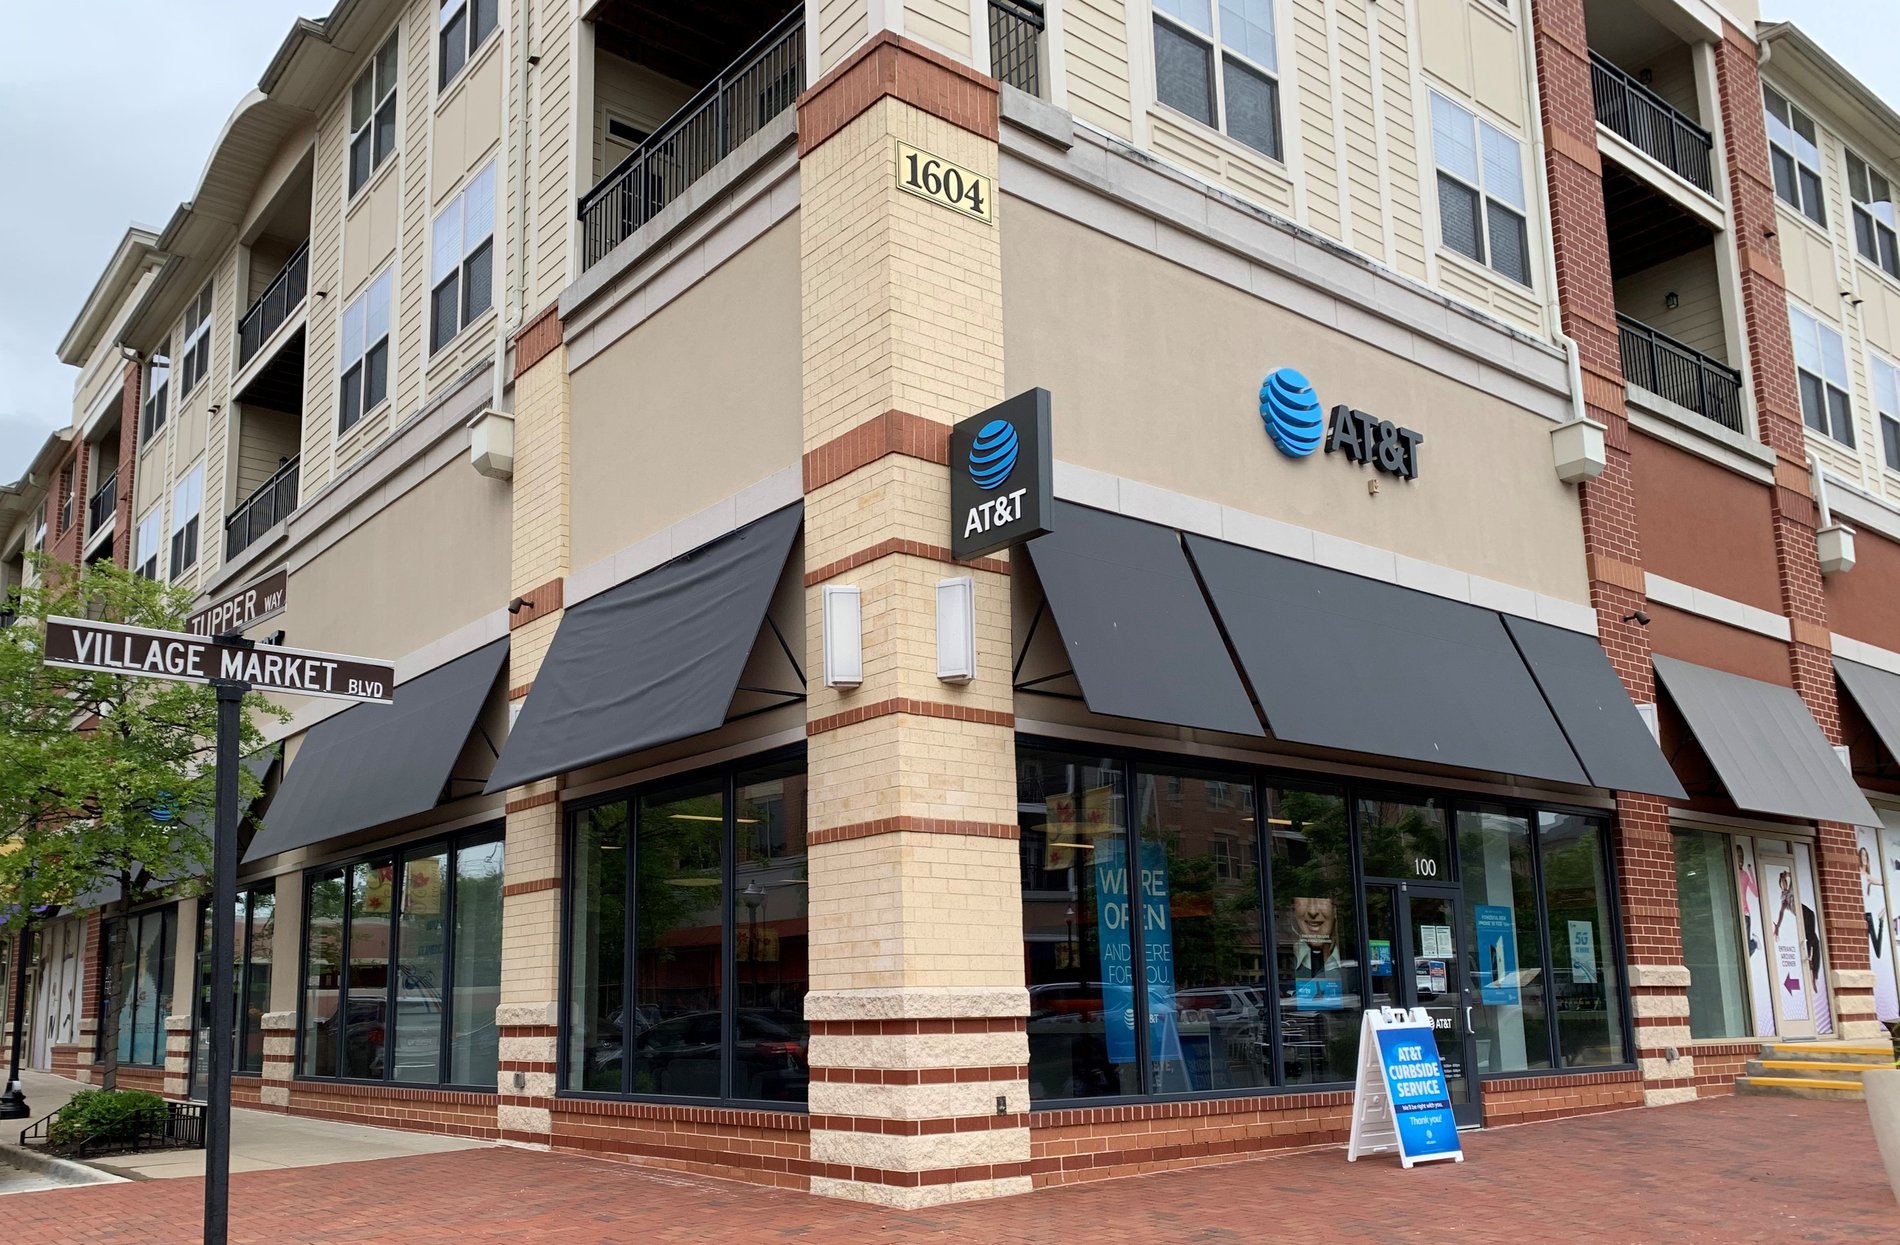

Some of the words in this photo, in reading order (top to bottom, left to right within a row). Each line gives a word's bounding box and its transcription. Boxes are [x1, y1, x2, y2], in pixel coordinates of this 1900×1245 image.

[905, 152, 985, 215] 1604
[1324, 404, 1424, 480] AT&T
[963, 487, 1027, 539] AT&T
[192, 589, 257, 638] TUPPER
[264, 589, 283, 613] WAY
[71, 629, 205, 677] VILLAGE
[220, 649, 338, 691] MARKET
[348, 678, 384, 698] BLVD
[1415, 857, 1437, 877] 100
[1099, 867, 1167, 896] WRE
[1104, 902, 1166, 931] OPN
[1574, 931, 1588, 945] 5G
[1104, 943, 1132, 961] AND
[1145, 943, 1171, 961] ERE
[1108, 965, 1133, 984] FOR
[1146, 965, 1171, 984] OU.
[1435, 1018, 1452, 1029] AT&T
[1398, 1046, 1423, 1062] AT&T
[1389, 1062, 1441, 1080] CURBSIDE
[1397, 1079, 1441, 1098] SERVICE
[1409, 1115, 1429, 1126] Thank
[1429, 1113, 1442, 1126] you!
